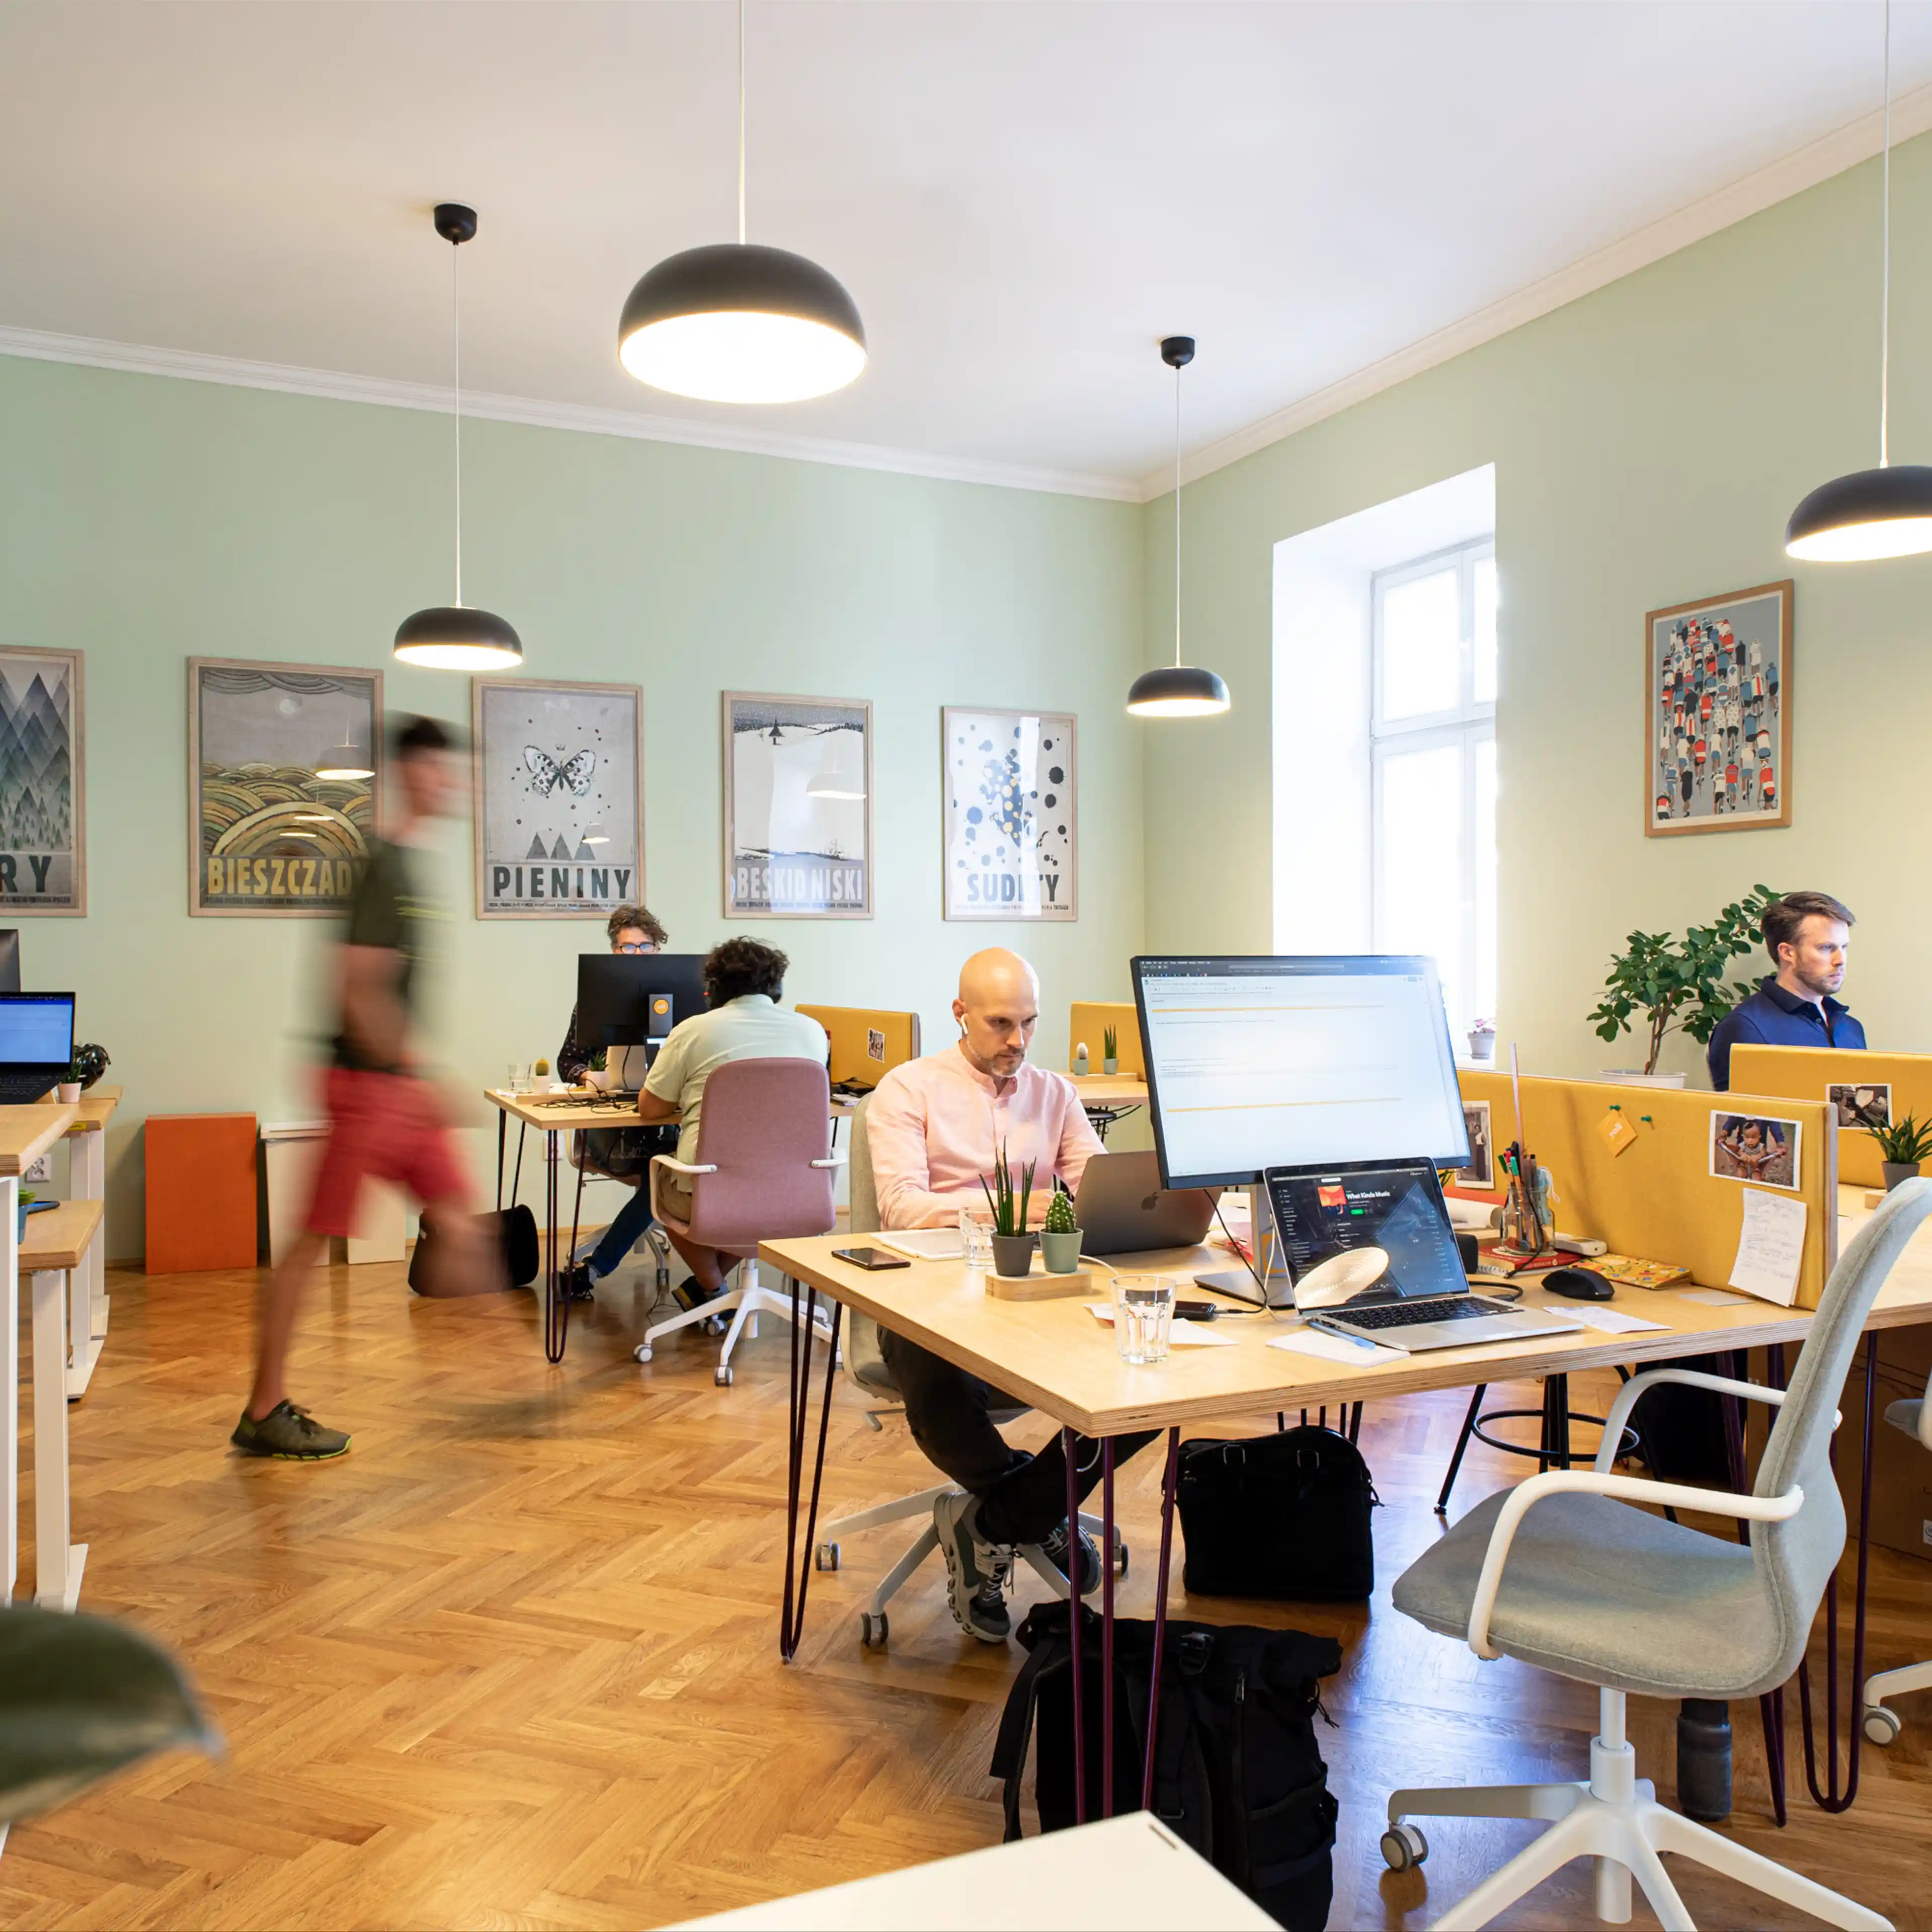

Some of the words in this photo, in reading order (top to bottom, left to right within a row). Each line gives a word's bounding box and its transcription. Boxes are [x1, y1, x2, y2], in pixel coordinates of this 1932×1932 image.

[493, 866, 631, 899] PIENINY
[737, 867, 806, 900] BESKID
[811, 868, 863, 901] NISKI
